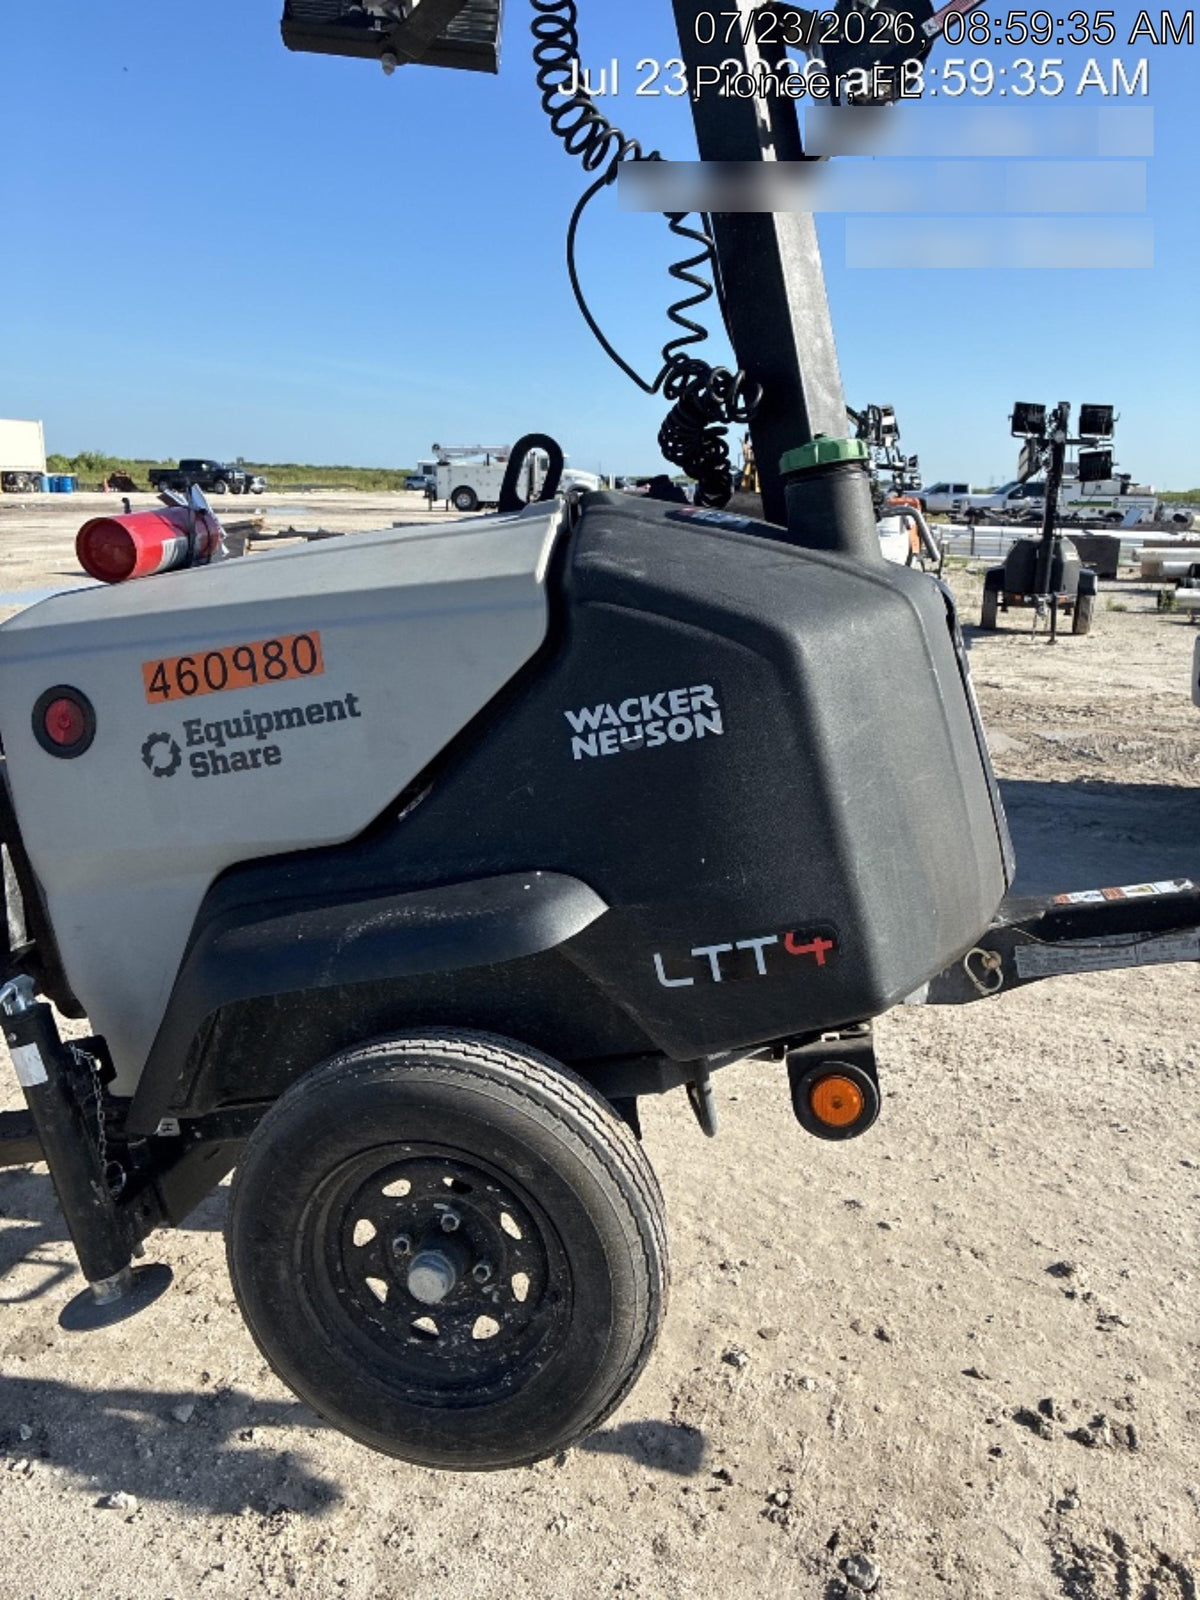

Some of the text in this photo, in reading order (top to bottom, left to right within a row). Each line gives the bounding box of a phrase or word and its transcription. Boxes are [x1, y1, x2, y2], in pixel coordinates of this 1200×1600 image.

[149, 634, 318, 700] 460980
[182, 693, 362, 748] Equipment
[564, 684, 719, 733] WACKER
[571, 709, 724, 760] NEUSON
[189, 744, 283, 778] Share
